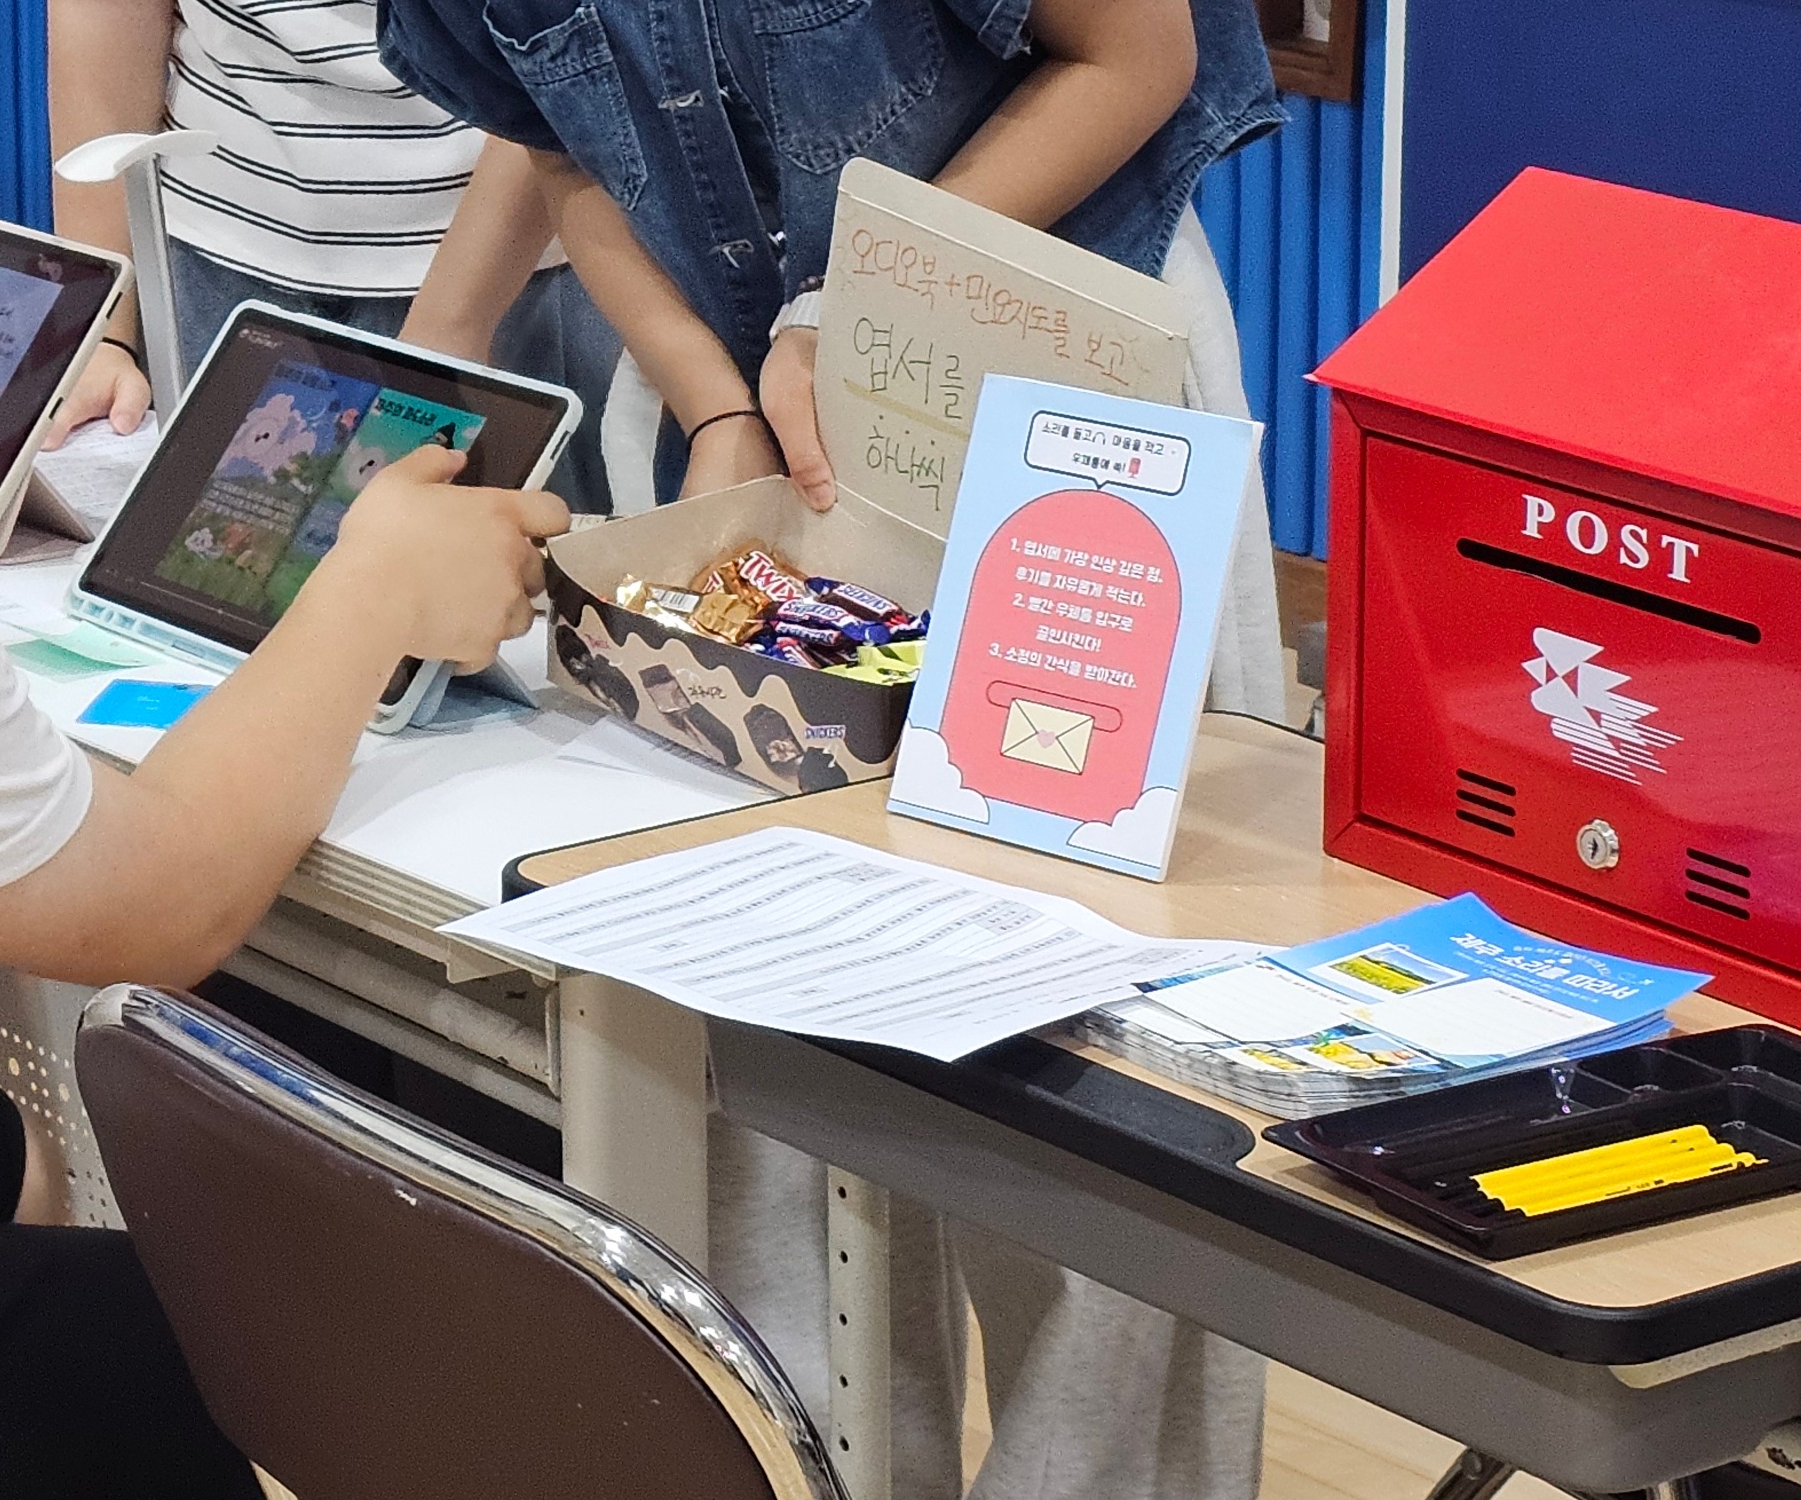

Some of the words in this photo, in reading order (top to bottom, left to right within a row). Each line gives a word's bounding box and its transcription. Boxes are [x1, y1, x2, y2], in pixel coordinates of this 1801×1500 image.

[853, 316, 966, 421] 엽서를
[1084, 333, 1130, 387] 보고
[1042, 421, 1070, 438] 소리를
[866, 424, 946, 512] 하나씩
[1010, 537, 1021, 553] 1.
[1063, 547, 1089, 567] 가장
[1089, 554, 1117, 574] 인상
[1117, 559, 1145, 580] 깊은
[1521, 493, 1699, 584] POST
[740, 551, 803, 601] TWIX
[1015, 565, 1052, 587] 후기를
[1053, 573, 1103, 598] 자유롭게
[1106, 584, 1146, 607] 적는다.
[1012, 592, 1026, 608] 2.
[1027, 596, 1055, 615] 빨간
[1055, 601, 1093, 624] 우체통
[1095, 610, 1134, 633] 입구로
[1035, 624, 1103, 653] 골인시킨다!
[988, 642, 1003, 659] 3.
[1004, 645, 1043, 667] 소정의
[1044, 654, 1082, 677] 간식을
[1084, 663, 1137, 688] 받아간다.
[1449, 932, 1505, 956] 제주
